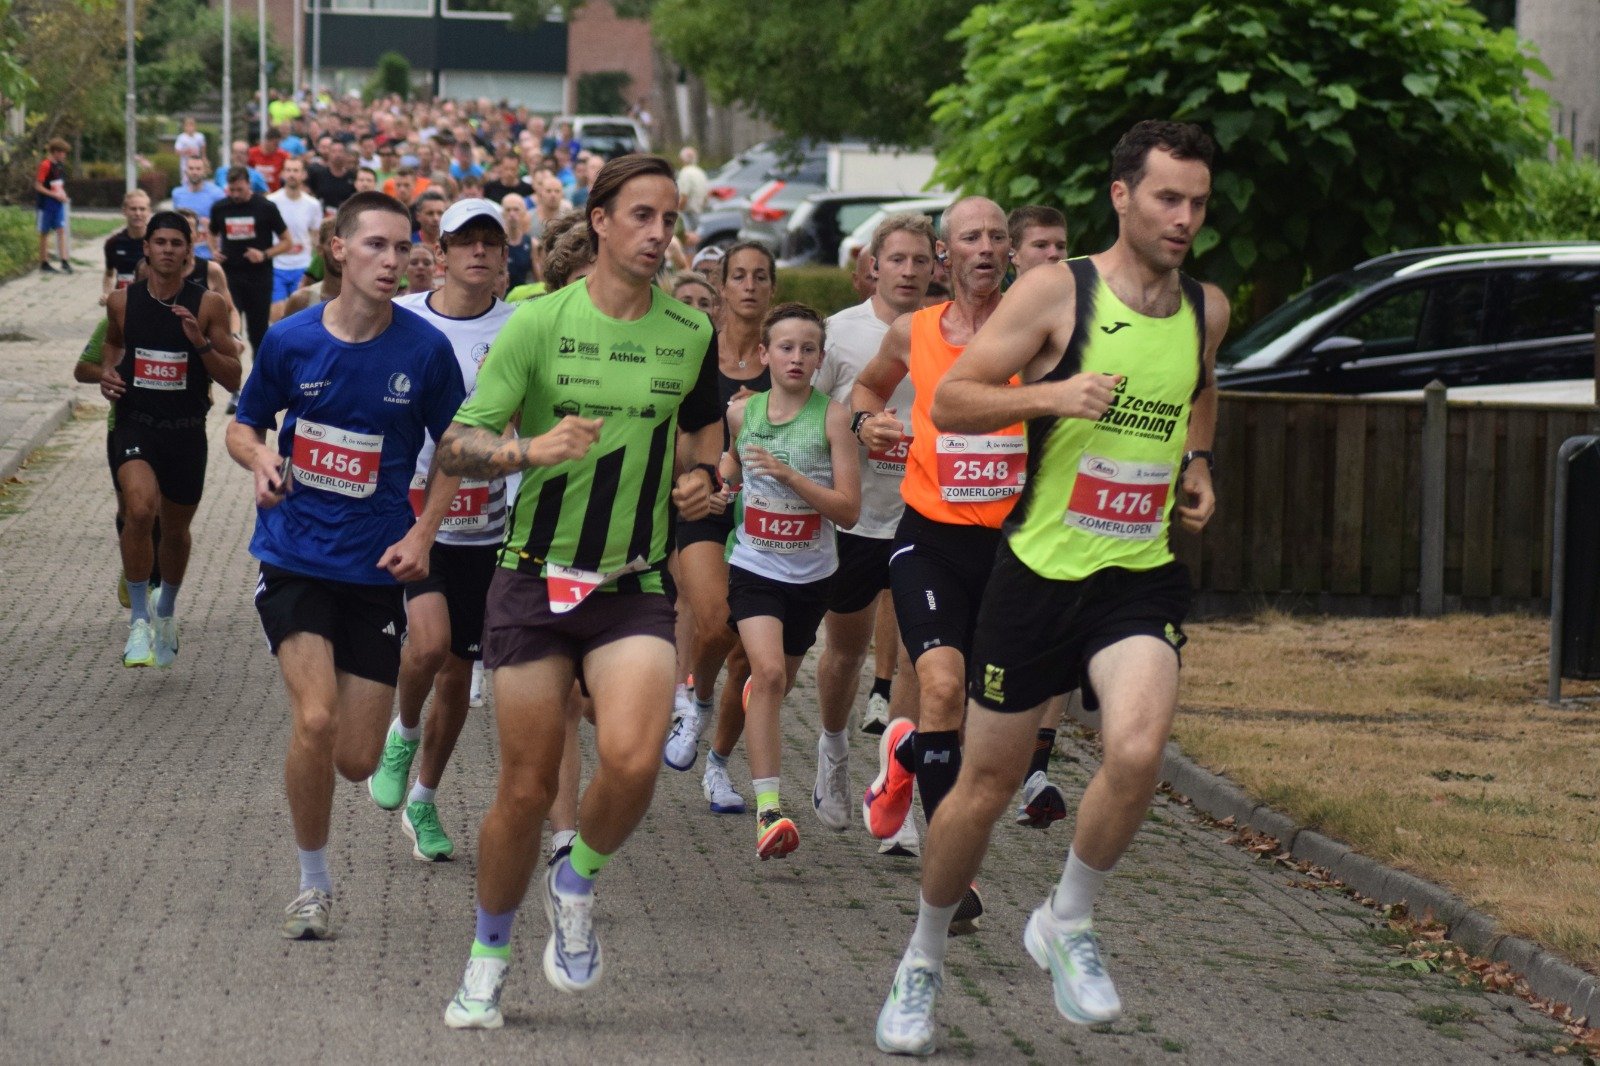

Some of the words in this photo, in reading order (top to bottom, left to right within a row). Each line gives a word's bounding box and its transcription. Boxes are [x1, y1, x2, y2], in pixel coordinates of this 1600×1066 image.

[665, 309, 699, 331] BIORACER
[609, 352, 646, 363] Athlex
[144, 364, 177, 378] 3463
[300, 381, 323, 389] CRAFT
[570, 377, 600, 386] EXPERTS
[309, 448, 361, 476] 1456
[953, 460, 1008, 481] 2548
[298, 470, 365, 493] ZOMERLOPEN
[946, 487, 1016, 498] ZOMERLOPEN
[1096, 489, 1152, 515] 1476
[758, 517, 805, 536] 1427
[1078, 515, 1152, 534] ZOMERLOPEN
[751, 536, 810, 550] ZOMERLOPEN
